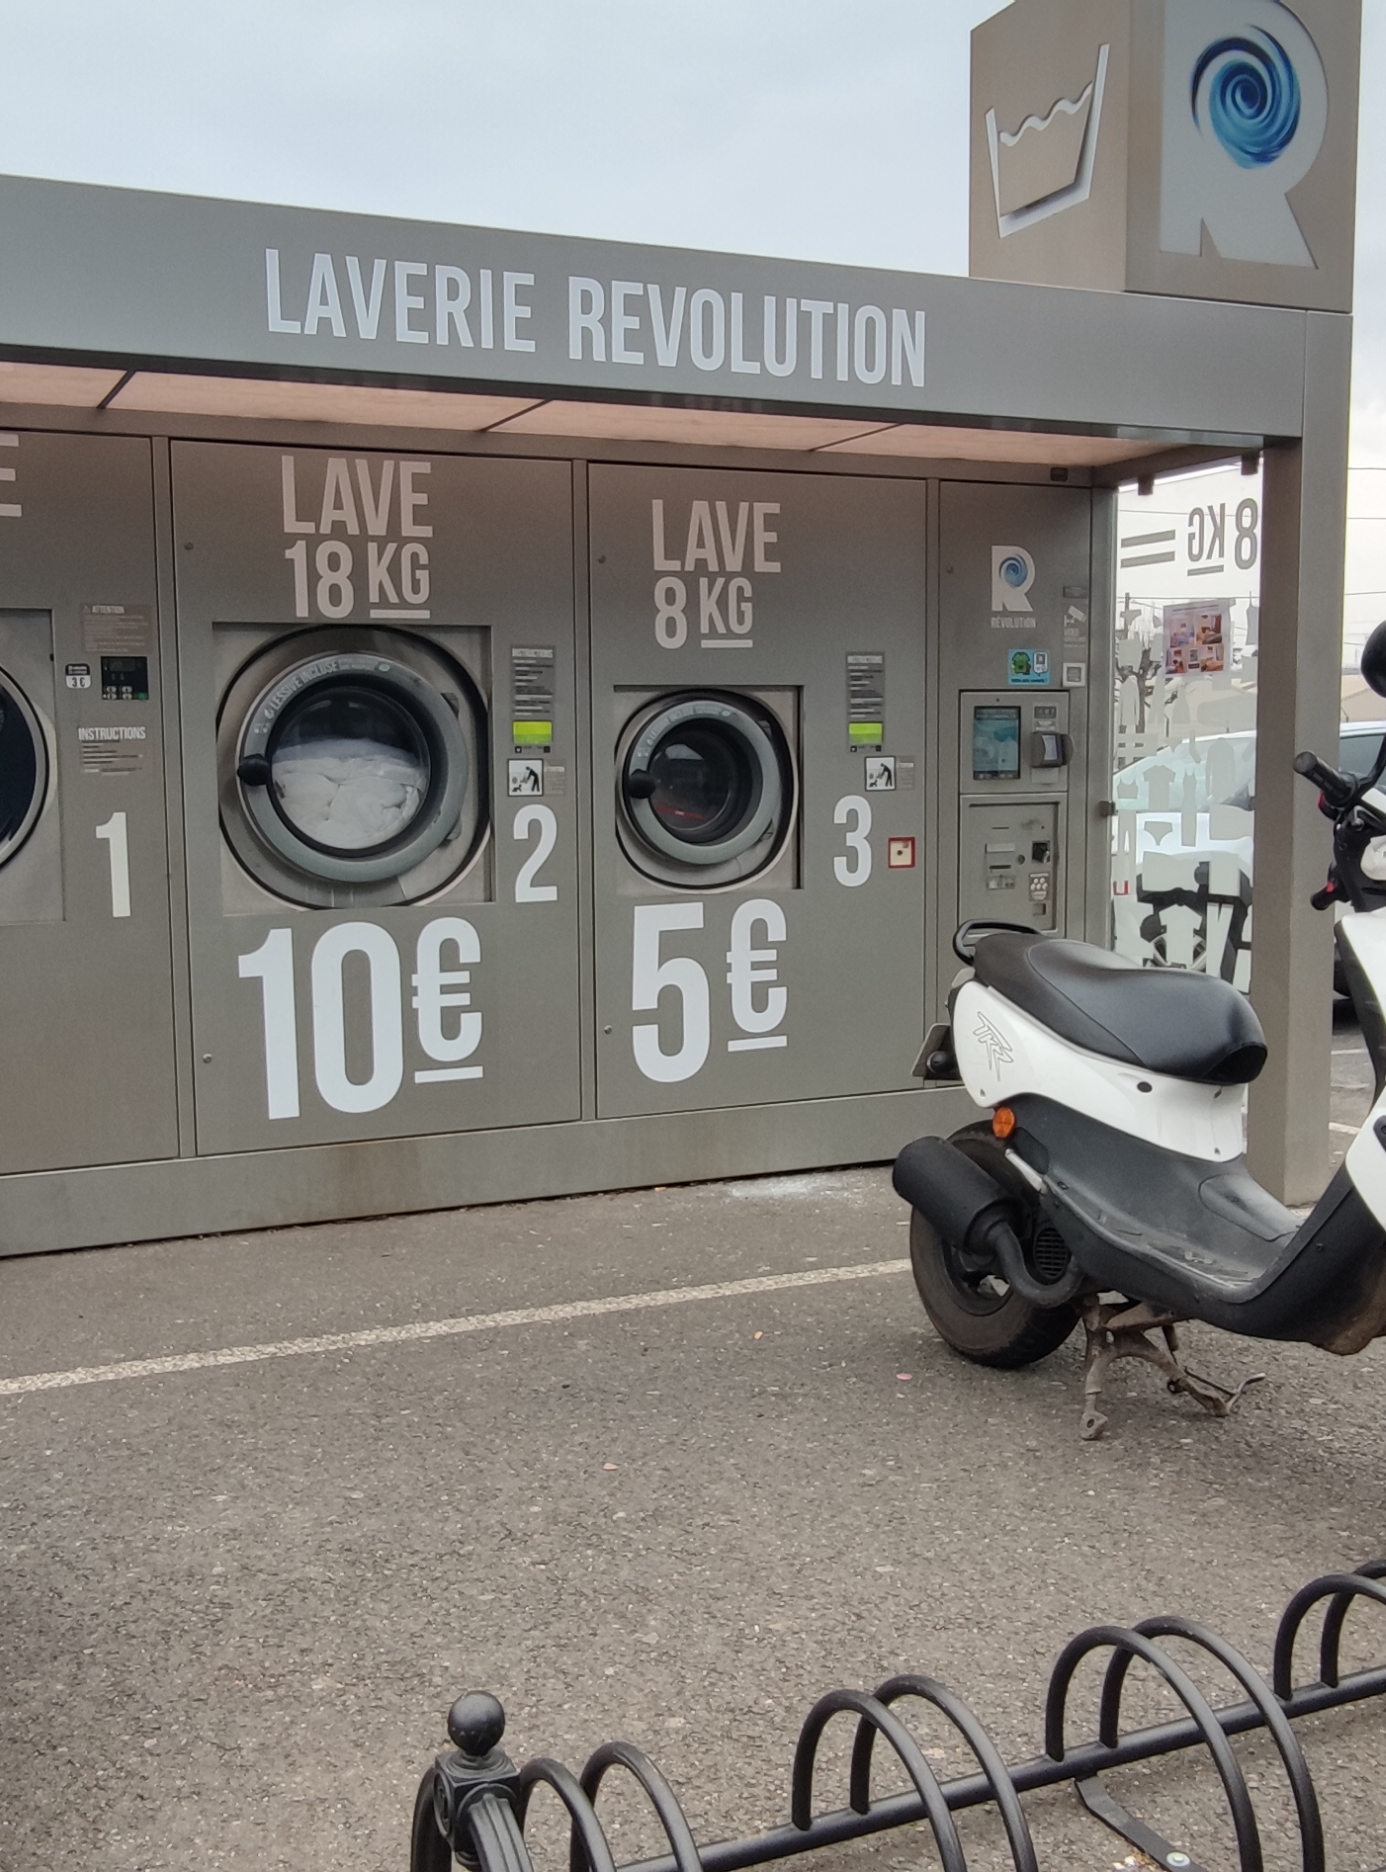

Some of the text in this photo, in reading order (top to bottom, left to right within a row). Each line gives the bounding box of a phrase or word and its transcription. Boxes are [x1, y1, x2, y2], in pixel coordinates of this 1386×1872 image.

[264, 247, 926, 388] LAVERIE REVOLUTION
[280, 455, 434, 538] LAVE
[651, 498, 782, 574] LAVE
[284, 540, 431, 620] 18 KG
[654, 576, 754, 649] 8 KG
[268, 676, 303, 711] LESSIVE
[300, 661, 339, 684] INCLUSE
[78, 726, 147, 741] INSTRUCTIONS
[95, 811, 131, 918] 1
[513, 804, 558, 903] 2
[833, 795, 873, 887] 3
